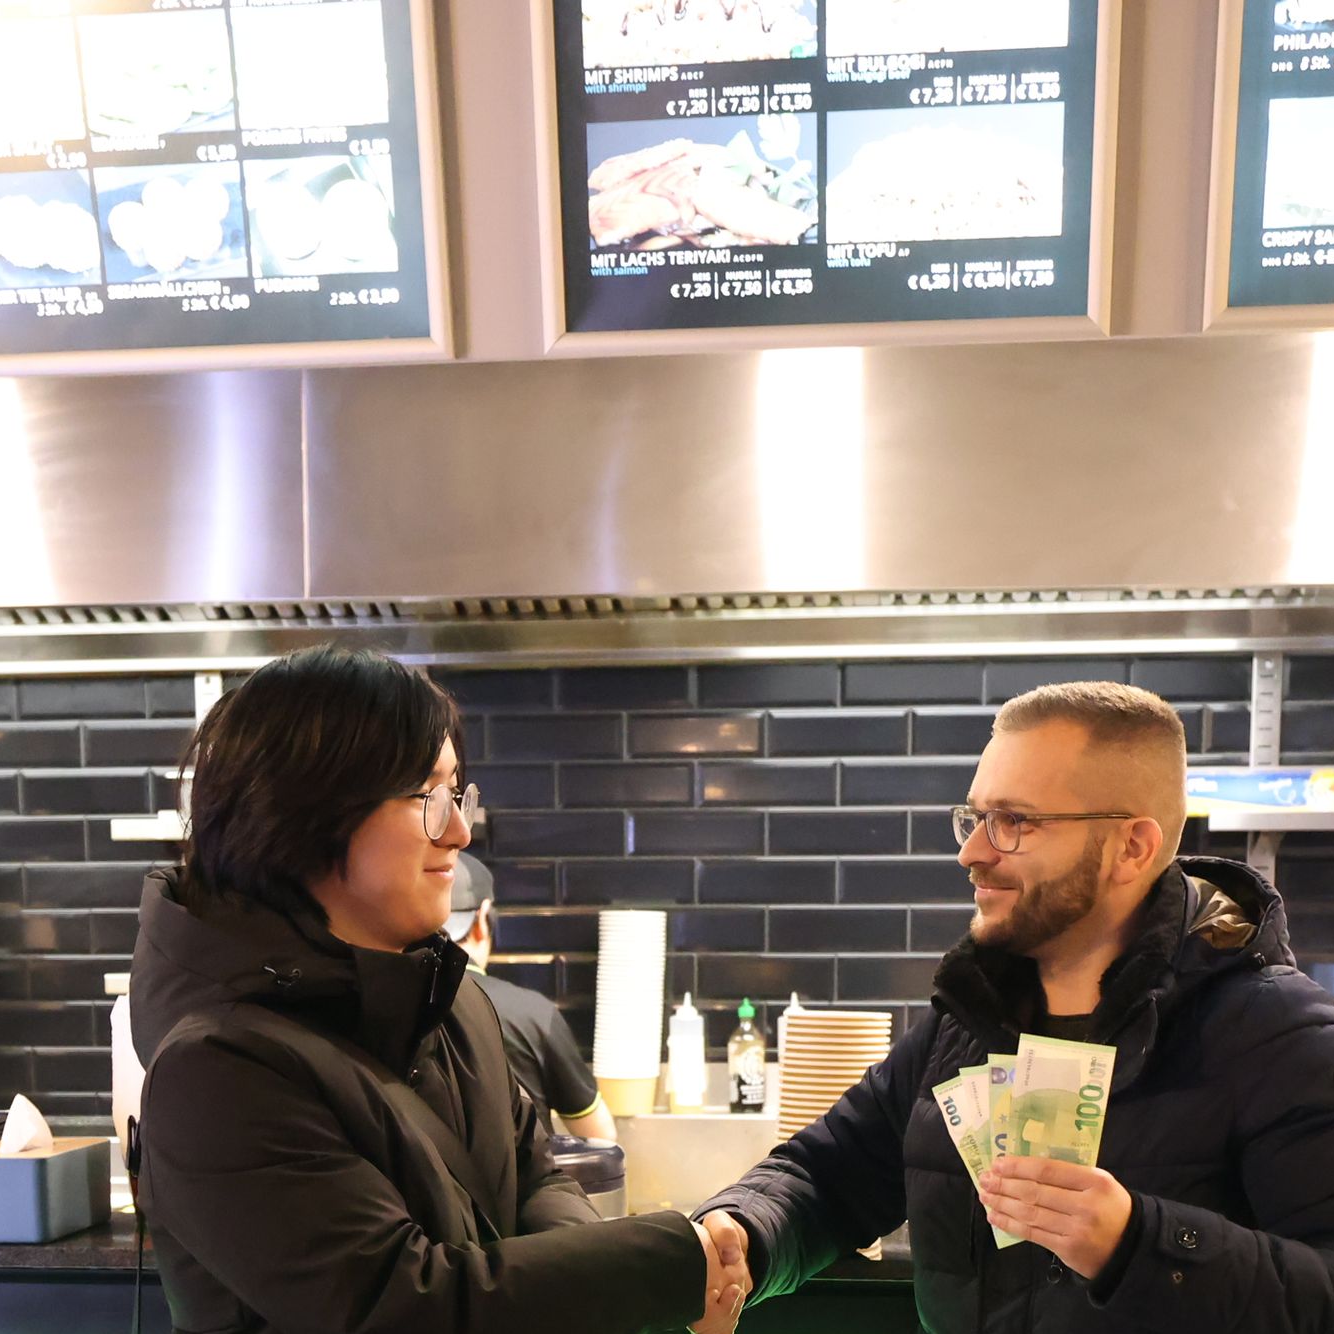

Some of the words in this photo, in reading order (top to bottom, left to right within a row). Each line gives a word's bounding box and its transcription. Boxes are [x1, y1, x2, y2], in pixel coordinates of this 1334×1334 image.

[827, 57, 855, 74] MIT
[585, 70, 611, 84] MIT
[614, 67, 678, 83] SHRIMPS
[585, 83, 606, 94] with
[608, 82, 646, 94] shrimps
[666, 101, 675, 115] €
[678, 99, 708, 117] 7,20
[717, 98, 728, 113] €
[729, 96, 760, 114] 7,50
[769, 96, 780, 111] €
[1262, 230, 1314, 247] CRISPY
[591, 254, 617, 267] MIT
[620, 252, 665, 267] LACHS
[668, 249, 730, 265] TERIYAKI
[827, 244, 855, 260] MIT
[857, 242, 896, 258] TOFU
[591, 267, 612, 276] with
[613, 265, 647, 275] salmon
[670, 284, 680, 298] €
[682, 283, 712, 299] 7,20
[721, 282, 731, 297] €
[732, 281, 763, 297] 7,50
[771, 280, 782, 295] €
[943, 1096, 962, 1127] 100
[1074, 1084, 1104, 1131] 100
